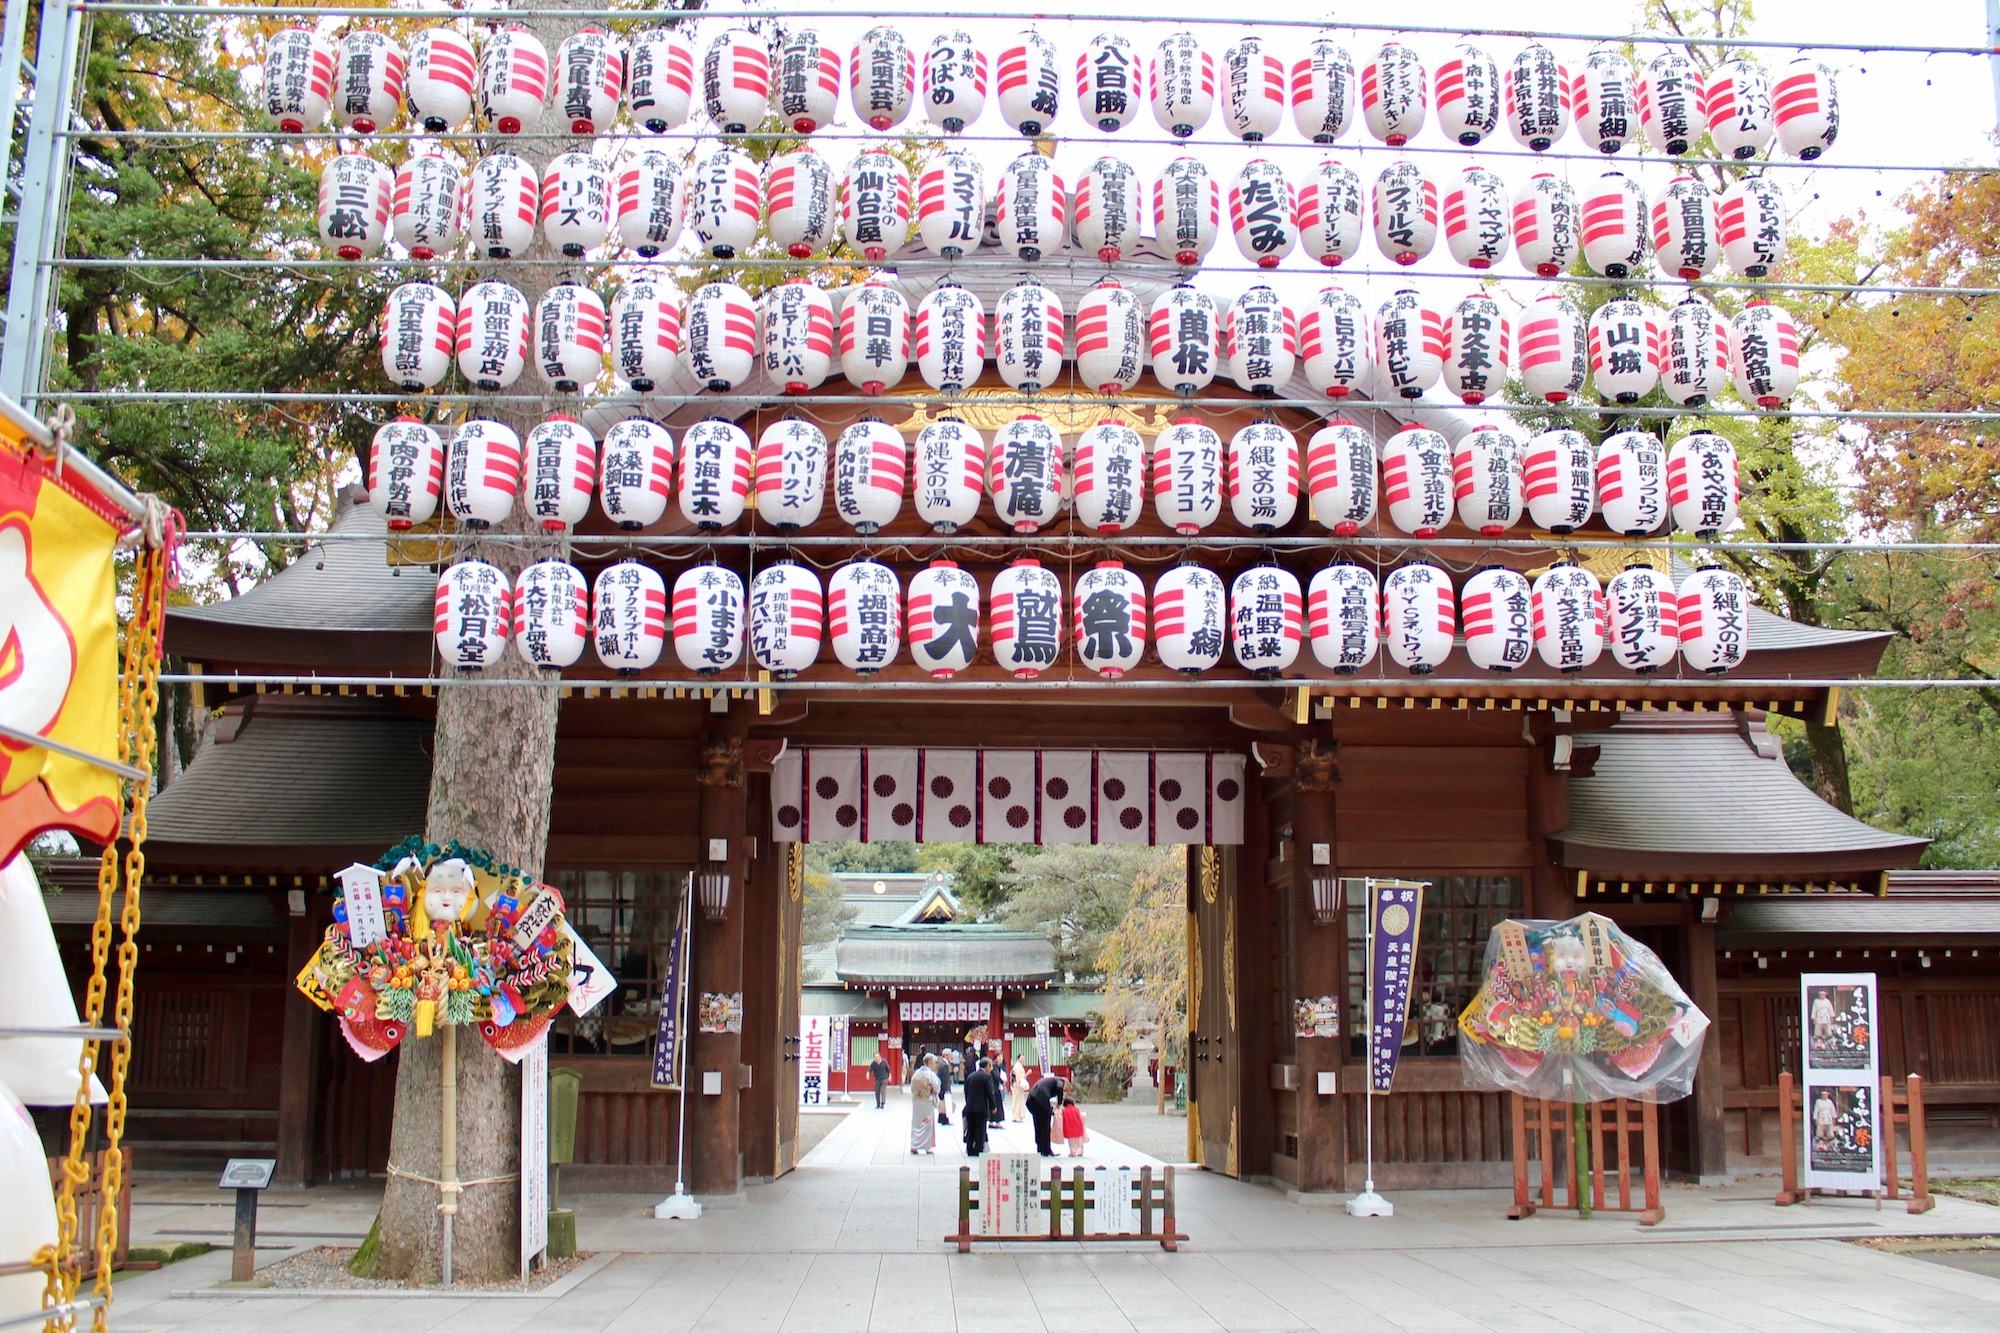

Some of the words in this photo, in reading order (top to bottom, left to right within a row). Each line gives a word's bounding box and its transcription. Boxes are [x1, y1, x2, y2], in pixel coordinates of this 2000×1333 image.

[265, 51, 284, 116] 府中支店
[345, 54, 375, 116] 番場屋
[416, 47, 429, 71] 府中
[491, 48, 509, 96] 専門店街
[564, 46, 596, 120] 吉亀寿司
[782, 45, 810, 116] 一藤建設
[931, 47, 958, 106] つばめ
[1094, 45, 1130, 115] 八百勝
[1398, 60, 1415, 115] ケンタッキー
[1382, 62, 1402, 131] フライドチキン
[1465, 64, 1485, 127] 府中支店
[1513, 67, 1538, 137] 東京支店
[1599, 82, 1628, 139] 三浦組
[1737, 81, 1758, 132] シャルム
[327, 184, 368, 241] 三松
[435, 178, 458, 238] 漫画喫茶
[560, 180, 585, 226] リーズ
[587, 174, 606, 224] 保険の
[710, 169, 728, 228] こーひー
[852, 172, 884, 244] 仙台屋
[949, 172, 976, 240] スマイル
[1242, 180, 1288, 253] たくみ
[1325, 186, 1342, 253] コーポレーション
[1680, 197, 1709, 268] 岩田石材店
[1754, 193, 1781, 264] むら木ビル
[565, 302, 577, 342] 有限会社
[857, 287, 903, 307] 奉納
[1454, 300, 1501, 318] 奉納
[1600, 303, 1644, 320] 奉納
[479, 300, 513, 377] 服部工務店
[541, 301, 567, 378] 吉亀寿司
[765, 311, 780, 371] 府中店
[1001, 312, 1016, 366] 府中支店
[1172, 308, 1210, 375] 萬作
[1235, 317, 1247, 351] 株式会社
[1244, 307, 1274, 381] 一藤建設
[1457, 313, 1494, 391] 中久本店
[1607, 323, 1642, 377] 山城
[382, 424, 430, 444] 奉納
[531, 423, 576, 440] 奉納
[608, 424, 652, 441] 奉納
[689, 425, 734, 442] 奉納
[921, 423, 964, 443] 奉納
[1007, 423, 1054, 441] 奉納
[1096, 427, 1141, 447] 奉納
[1172, 426, 1218, 446] 奉納
[1241, 426, 1286, 445] 奉納
[385, 442, 420, 518] 肉の伊勢屋
[450, 440, 473, 517] 馬場製作所
[534, 438, 562, 517] 吉田呉服店
[605, 453, 626, 516] 鉄鋼工業
[621, 450, 643, 488] 桑田
[692, 440, 721, 516] 内海土木
[782, 450, 804, 510] パークス
[804, 445, 822, 503] グリーン
[855, 444, 871, 486] 総合建築
[923, 442, 953, 509] 縄文の湯
[1004, 440, 1046, 517] 清庵
[1177, 450, 1195, 512] フラココ
[1200, 447, 1217, 512] カラオケ
[1246, 445, 1278, 518] 縄文の湯
[1344, 441, 1375, 521] 増田生花店
[1417, 449, 1446, 526] 金子造花店
[1564, 451, 1591, 523] 藤輝工業
[1699, 452, 1728, 527] あやべ商店
[452, 567, 500, 585] 奉納
[459, 583, 491, 596] 中川原
[526, 566, 573, 587] 奉納
[550, 582, 564, 627] 有限会社
[563, 584, 578, 612] 是政
[599, 568, 643, 591] 奉納
[699, 571, 742, 591] 奉納
[849, 569, 893, 587] 奉納
[1082, 570, 1129, 591] 奉納
[1236, 573, 1281, 593] 奉納
[1331, 568, 1374, 588] 奉納
[1389, 569, 1433, 590] 奉納
[1544, 573, 1590, 592] 奉納
[1580, 589, 1596, 620] 学生服
[1611, 574, 1655, 596] 奉納
[456, 594, 491, 663] 松月堂
[622, 585, 644, 660] アクティブホーム
[702, 590, 738, 665] 小ますや
[752, 591, 785, 667] コパデカフェ
[773, 592, 789, 651] 珈琲専門店
[923, 591, 979, 663] 大
[1081, 589, 1133, 660] 祭
[1236, 606, 1256, 662] 府中店
[1256, 593, 1284, 659] 温野菜
[1617, 592, 1656, 665] ジェノワーズ
[1643, 592, 1660, 633] 洋菓子
[1710, 591, 1744, 664] 縄文の湯
[1381, 889, 1414, 902] 奉祝
[1383, 942, 1399, 1038] 天皇陛下御即位
[1395, 942, 1412, 1023] 皇紀二六七九年
[803, 1031, 824, 1104] 七五三受付
